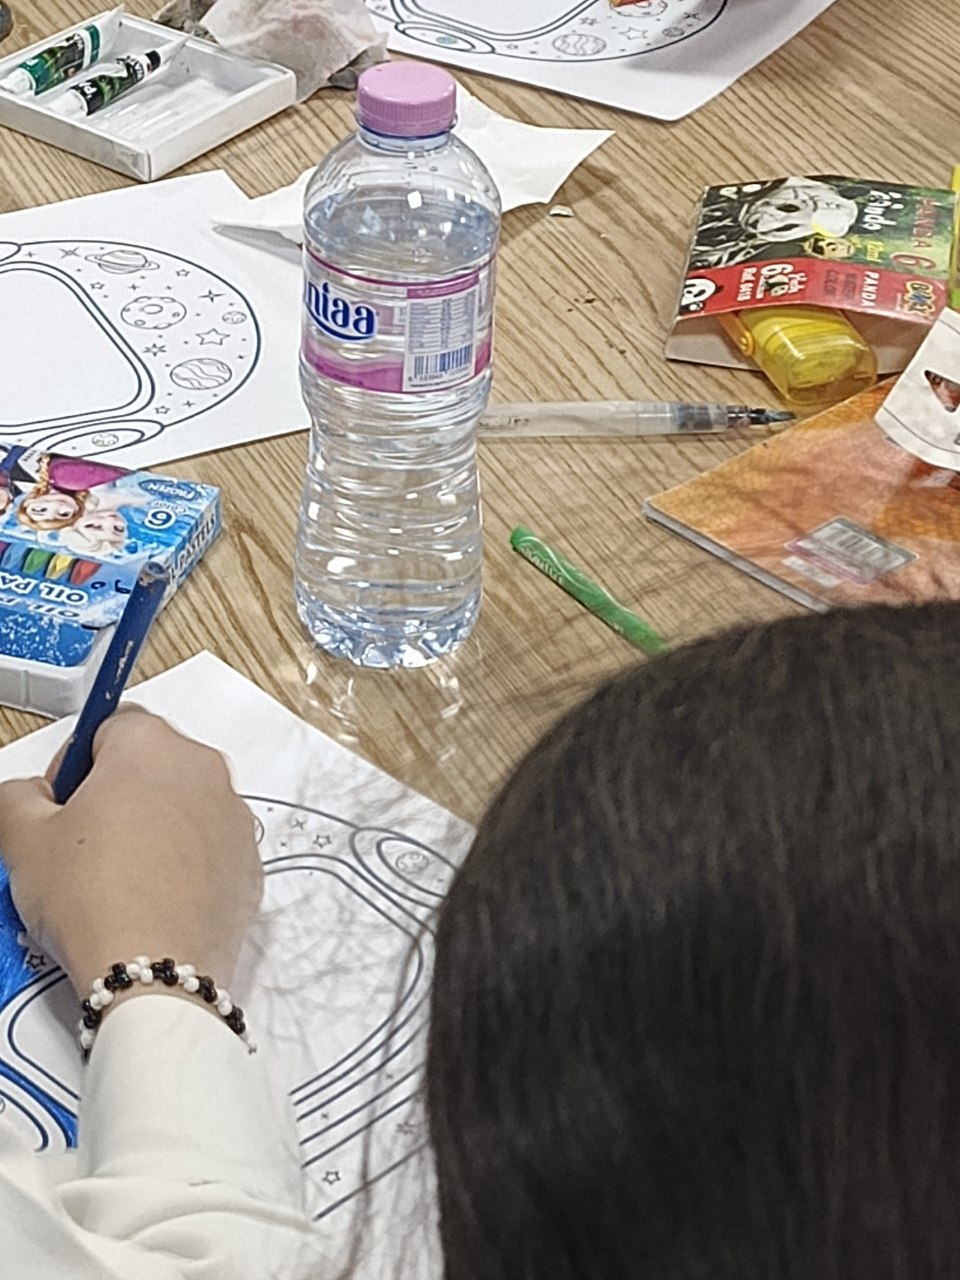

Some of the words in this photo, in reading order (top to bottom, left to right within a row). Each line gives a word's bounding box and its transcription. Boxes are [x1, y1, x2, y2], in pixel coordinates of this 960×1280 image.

[861, 271, 880, 307] PANDA
[147, 482, 196, 500] FROZEN
[146, 509, 175, 528] 6
[179, 512, 216, 570] PASTELS
[41, 584, 87, 604] OIL
